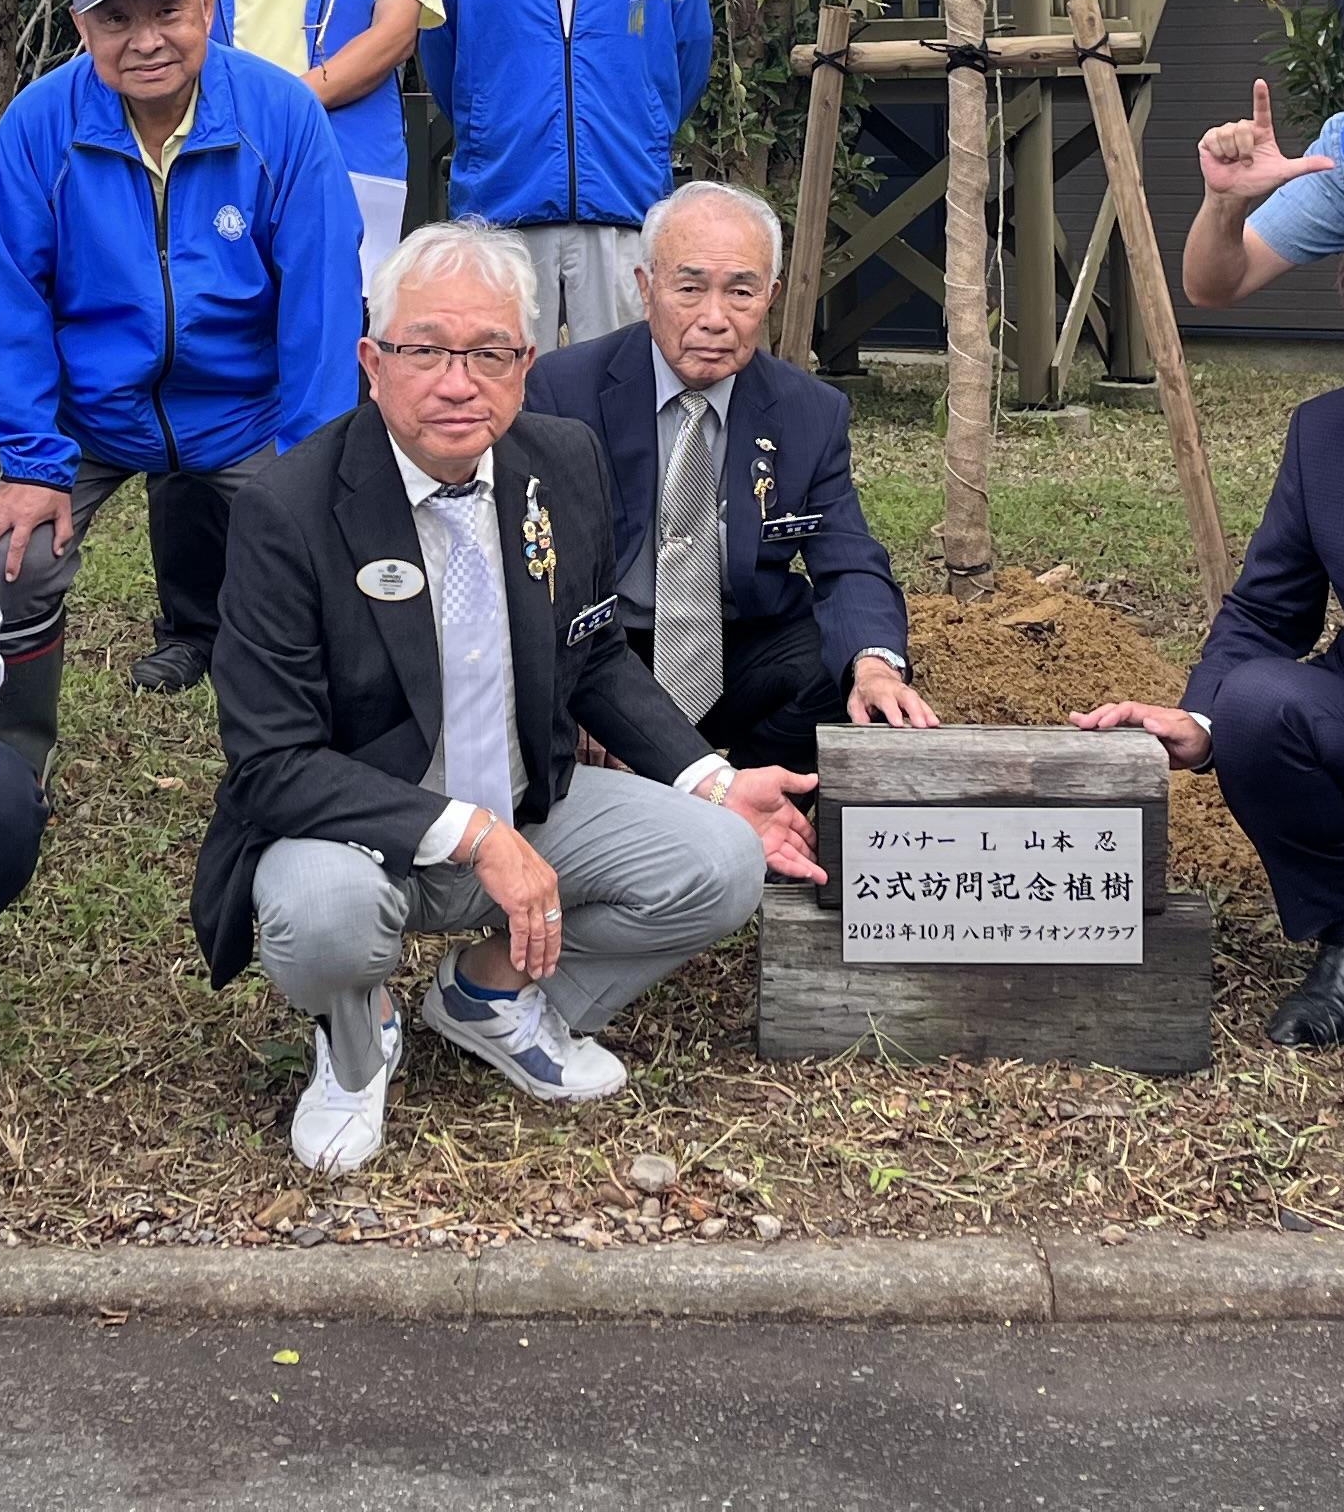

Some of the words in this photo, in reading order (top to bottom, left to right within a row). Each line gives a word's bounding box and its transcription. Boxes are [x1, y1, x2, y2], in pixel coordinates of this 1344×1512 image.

[868, 831, 955, 850] ガバナー
[980, 832, 997, 851] L
[1024, 830, 1074, 853] 山本
[1094, 831, 1117, 852] 忍
[852, 871, 1134, 902] 公式訪問記念植樹
[848, 923, 955, 942] 2023年10月
